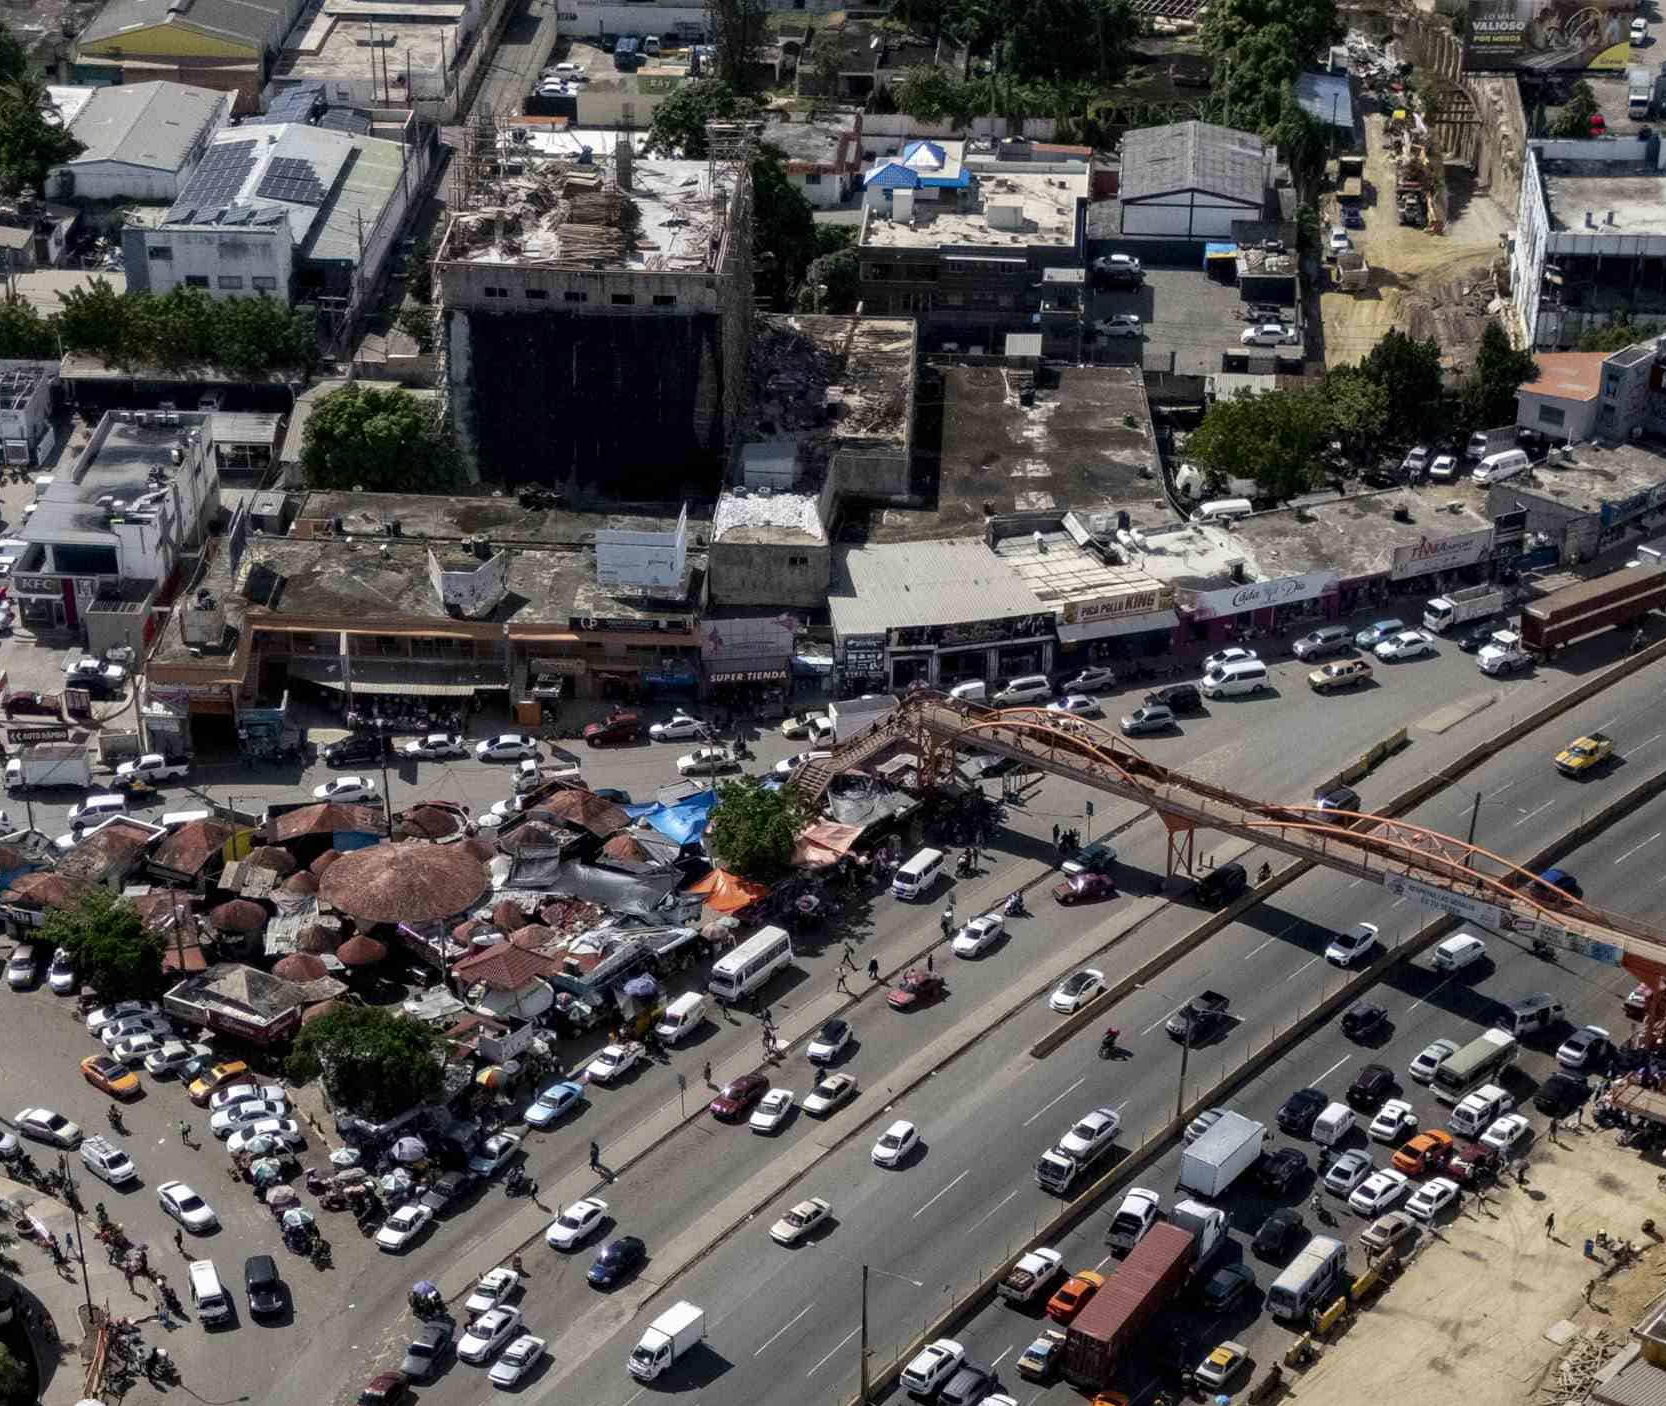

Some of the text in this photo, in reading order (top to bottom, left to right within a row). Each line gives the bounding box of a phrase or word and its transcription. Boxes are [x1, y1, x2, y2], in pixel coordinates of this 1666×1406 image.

[1472, 21, 1526, 31] VALIOSO
[21, 578, 54, 591] KFC
[1124, 592, 1156, 611] KING
[710, 671, 788, 682] SUPER TIENDA
